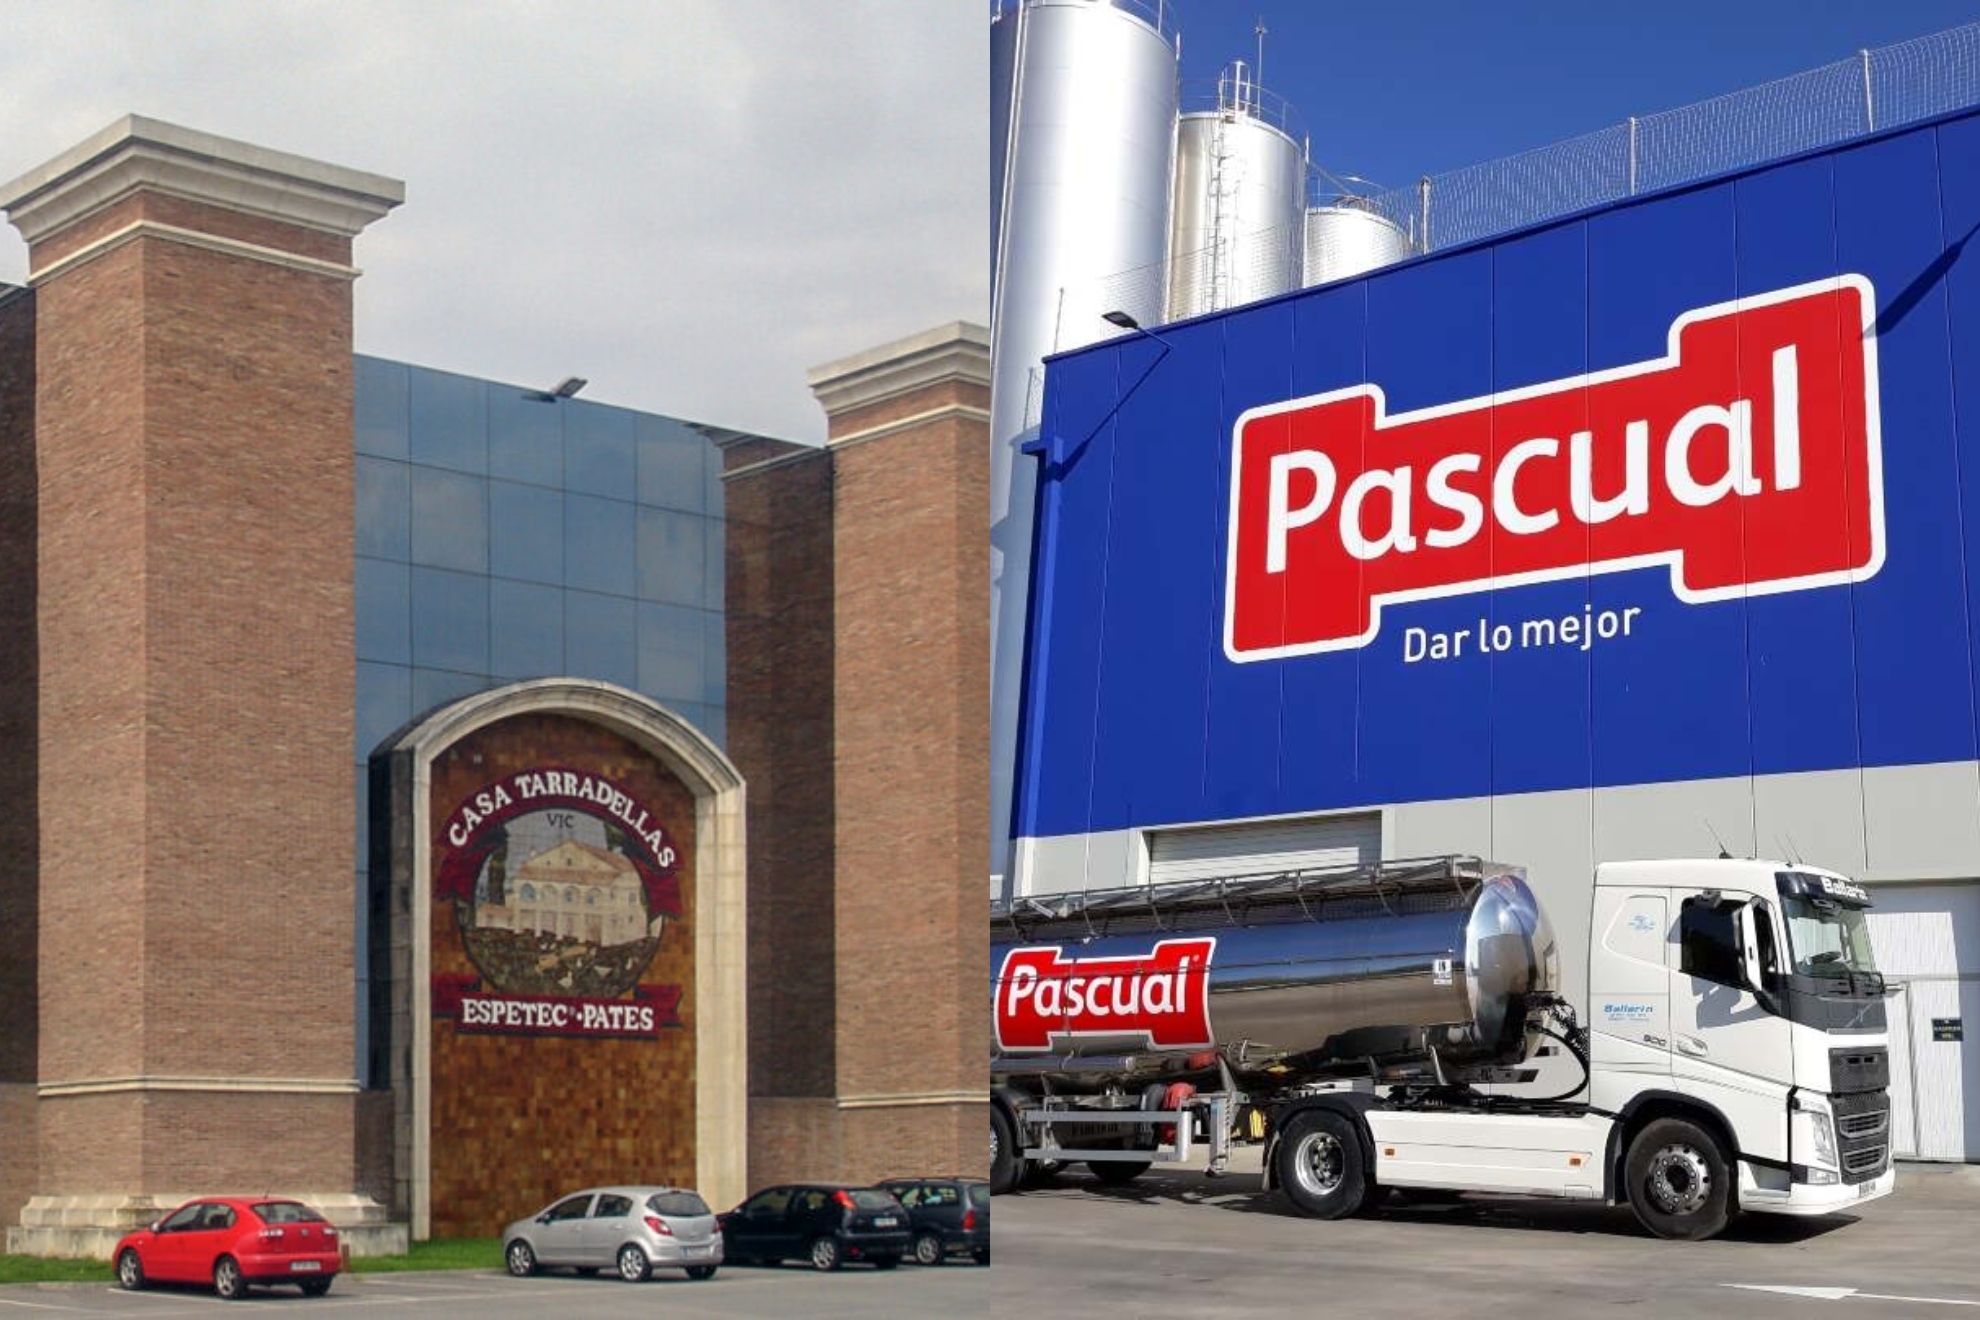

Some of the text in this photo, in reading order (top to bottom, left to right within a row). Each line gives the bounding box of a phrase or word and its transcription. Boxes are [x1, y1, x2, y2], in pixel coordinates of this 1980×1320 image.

[1265, 343, 1801, 574] Pascual
[1404, 604, 1641, 662] Dar lo mejor
[449, 771, 675, 867] CASA TARRADELLAS
[546, 813, 575, 830] VIC
[460, 998, 654, 1031] ESPETEC PATES
[1007, 955, 1190, 1017] Pascual
